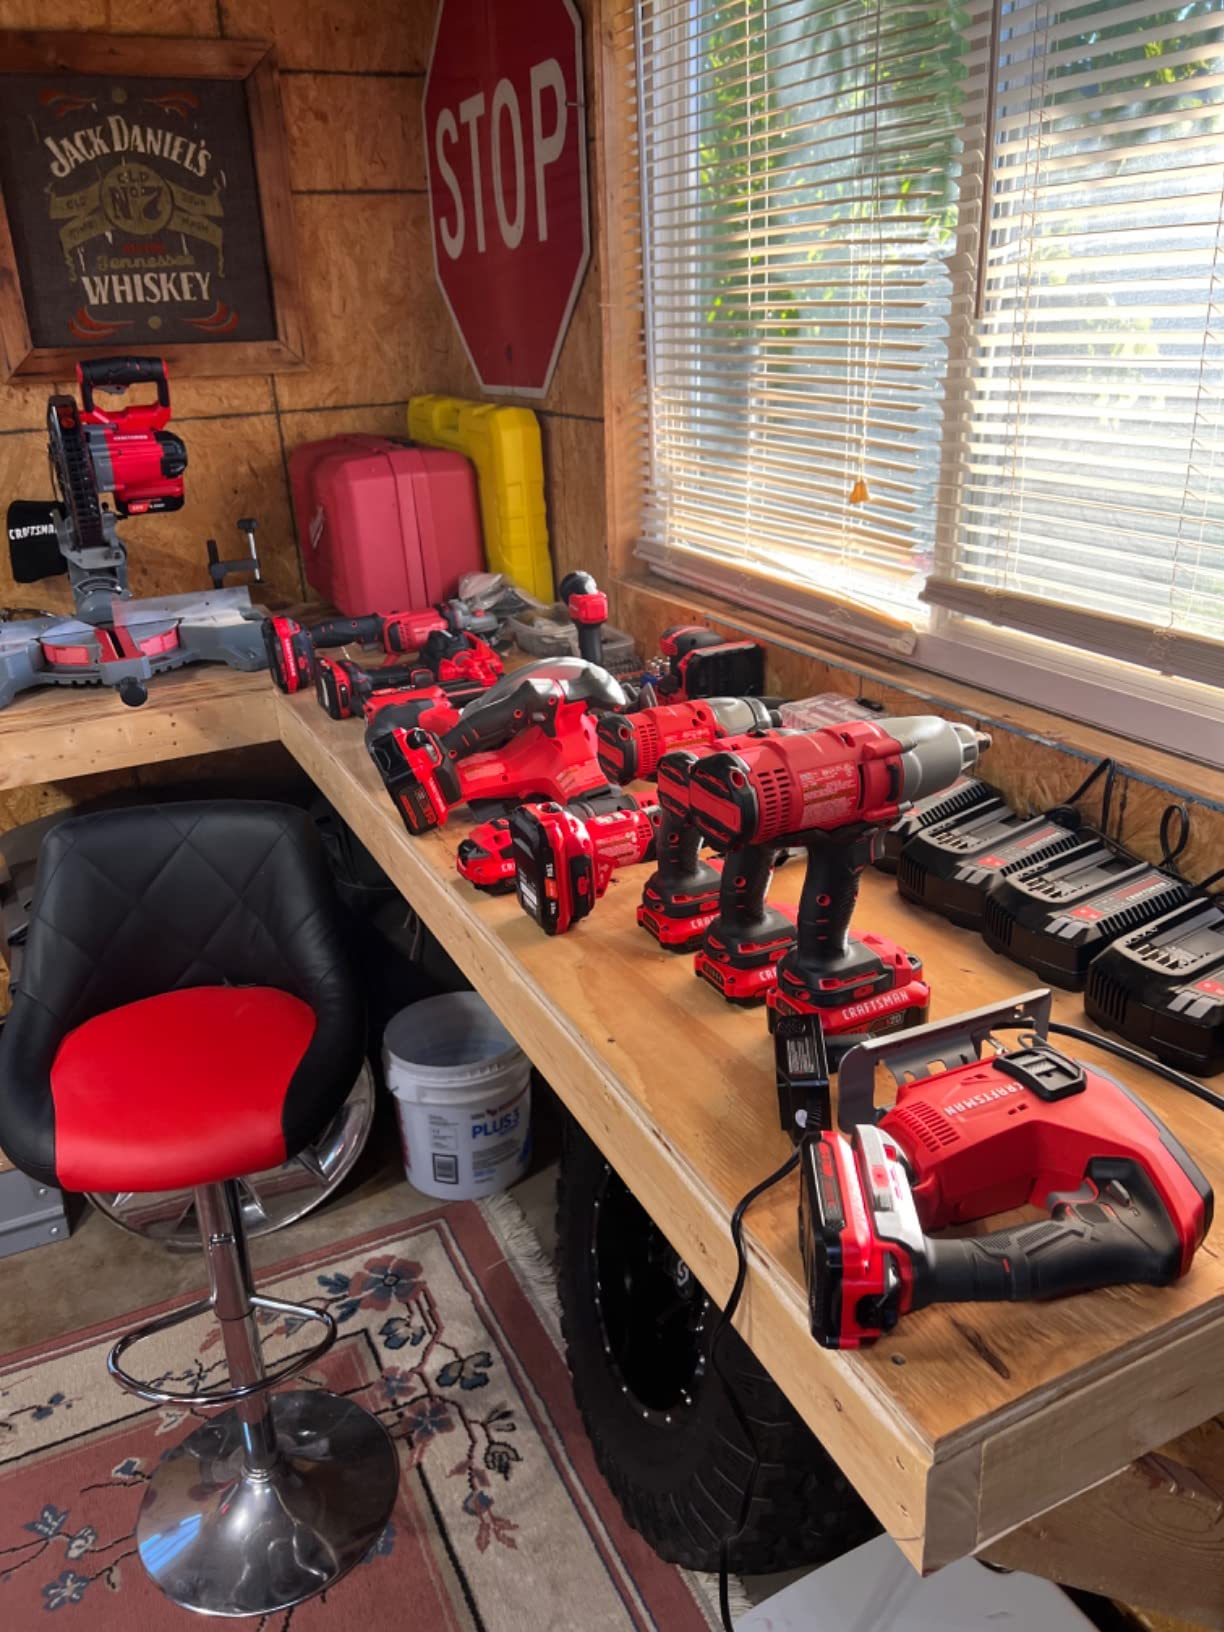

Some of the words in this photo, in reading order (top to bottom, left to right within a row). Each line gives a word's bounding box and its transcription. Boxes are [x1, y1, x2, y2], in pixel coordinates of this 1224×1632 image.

[45, 126, 110, 177] JACK
[107, 115, 212, 177] DANIEL'S
[436, 58, 567, 260] STOP
[81, 272, 211, 305] WHISKEY
[842, 991, 911, 1020] CRAFTSMAN
[944, 1082, 1026, 1116] CRAFTSMAN
